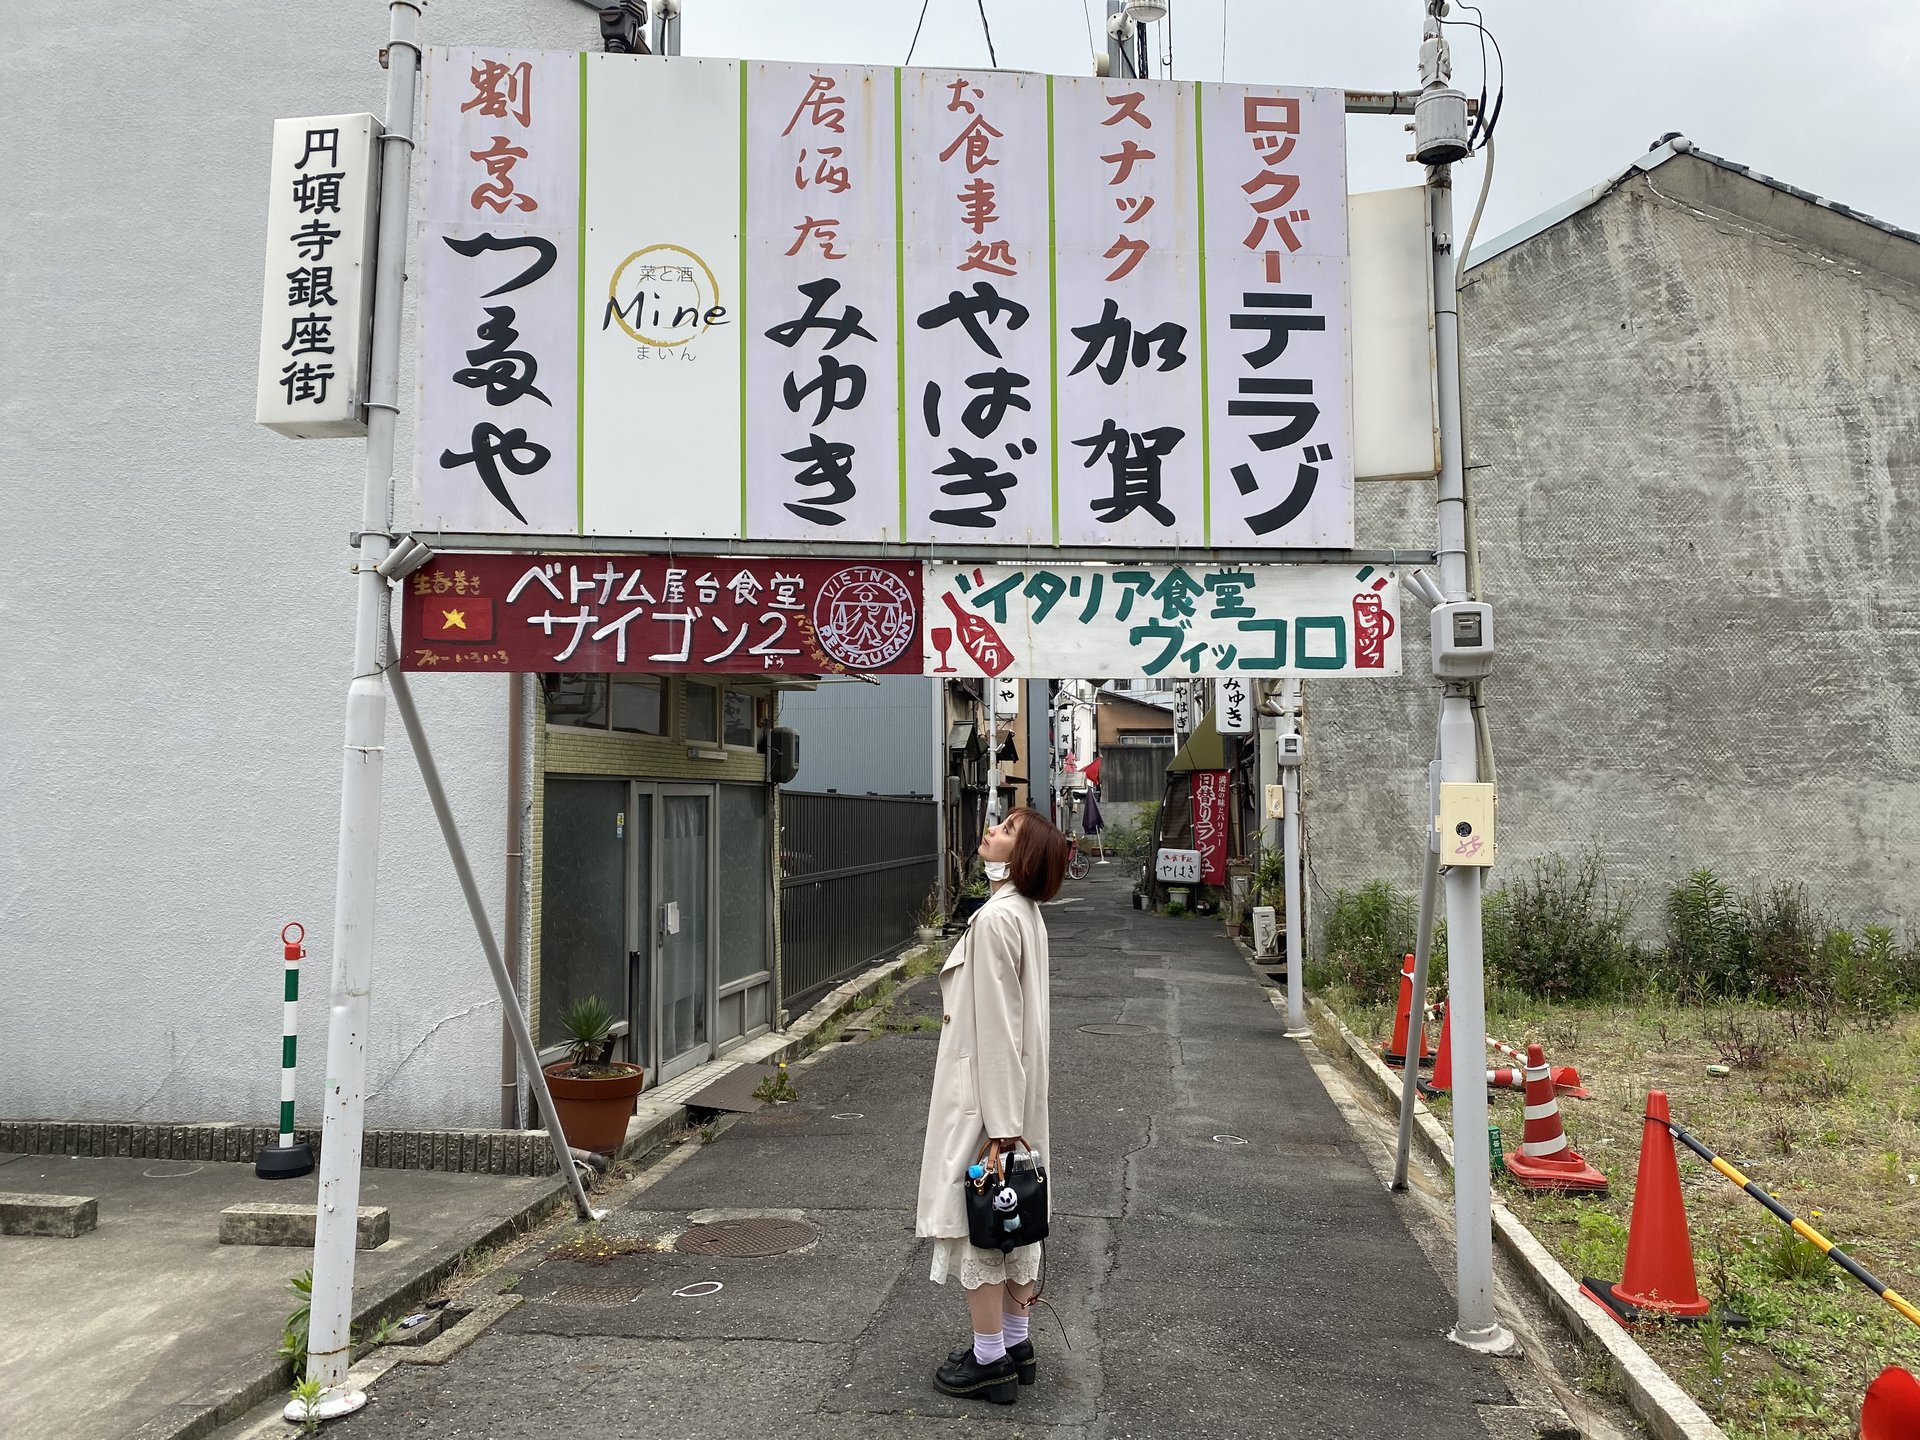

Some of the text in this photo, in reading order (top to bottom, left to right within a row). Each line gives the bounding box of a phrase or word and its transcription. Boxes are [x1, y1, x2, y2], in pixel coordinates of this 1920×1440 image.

[463, 60, 539, 213] 割烹
[939, 78, 1017, 277] お食事処
[1101, 91, 1156, 282] スナック
[1242, 96, 1311, 283] ロックバー
[279, 128, 346, 406] 円頓寺銀座街
[640, 265, 693, 282] 菜と酒
[602, 290, 731, 331] Mine
[637, 345, 696, 361] まいん
[764, 277, 878, 527] みゆき
[916, 281, 1038, 528] やはぎ
[1067, 297, 1188, 528] 加賀
[1227, 292, 1334, 536] テラゾ
[413, 570, 480, 596] 生春巻き
[505, 562, 806, 610] ベトナム屋台食堂
[823, 570, 908, 602] VIETNAM
[971, 567, 1257, 625] イタリア食堂
[819, 610, 913, 667] RESTAURANT
[963, 617, 998, 670] パスタ
[1129, 616, 1347, 676] ヴィッコロ
[1357, 605, 1380, 665] ピッツァ
[1060, 715, 1070, 744] 加賀
[1175, 687, 1188, 728] やはぎ
[1223, 677, 1246, 728] みゆき
[1159, 864, 1197, 879] やはぎ
